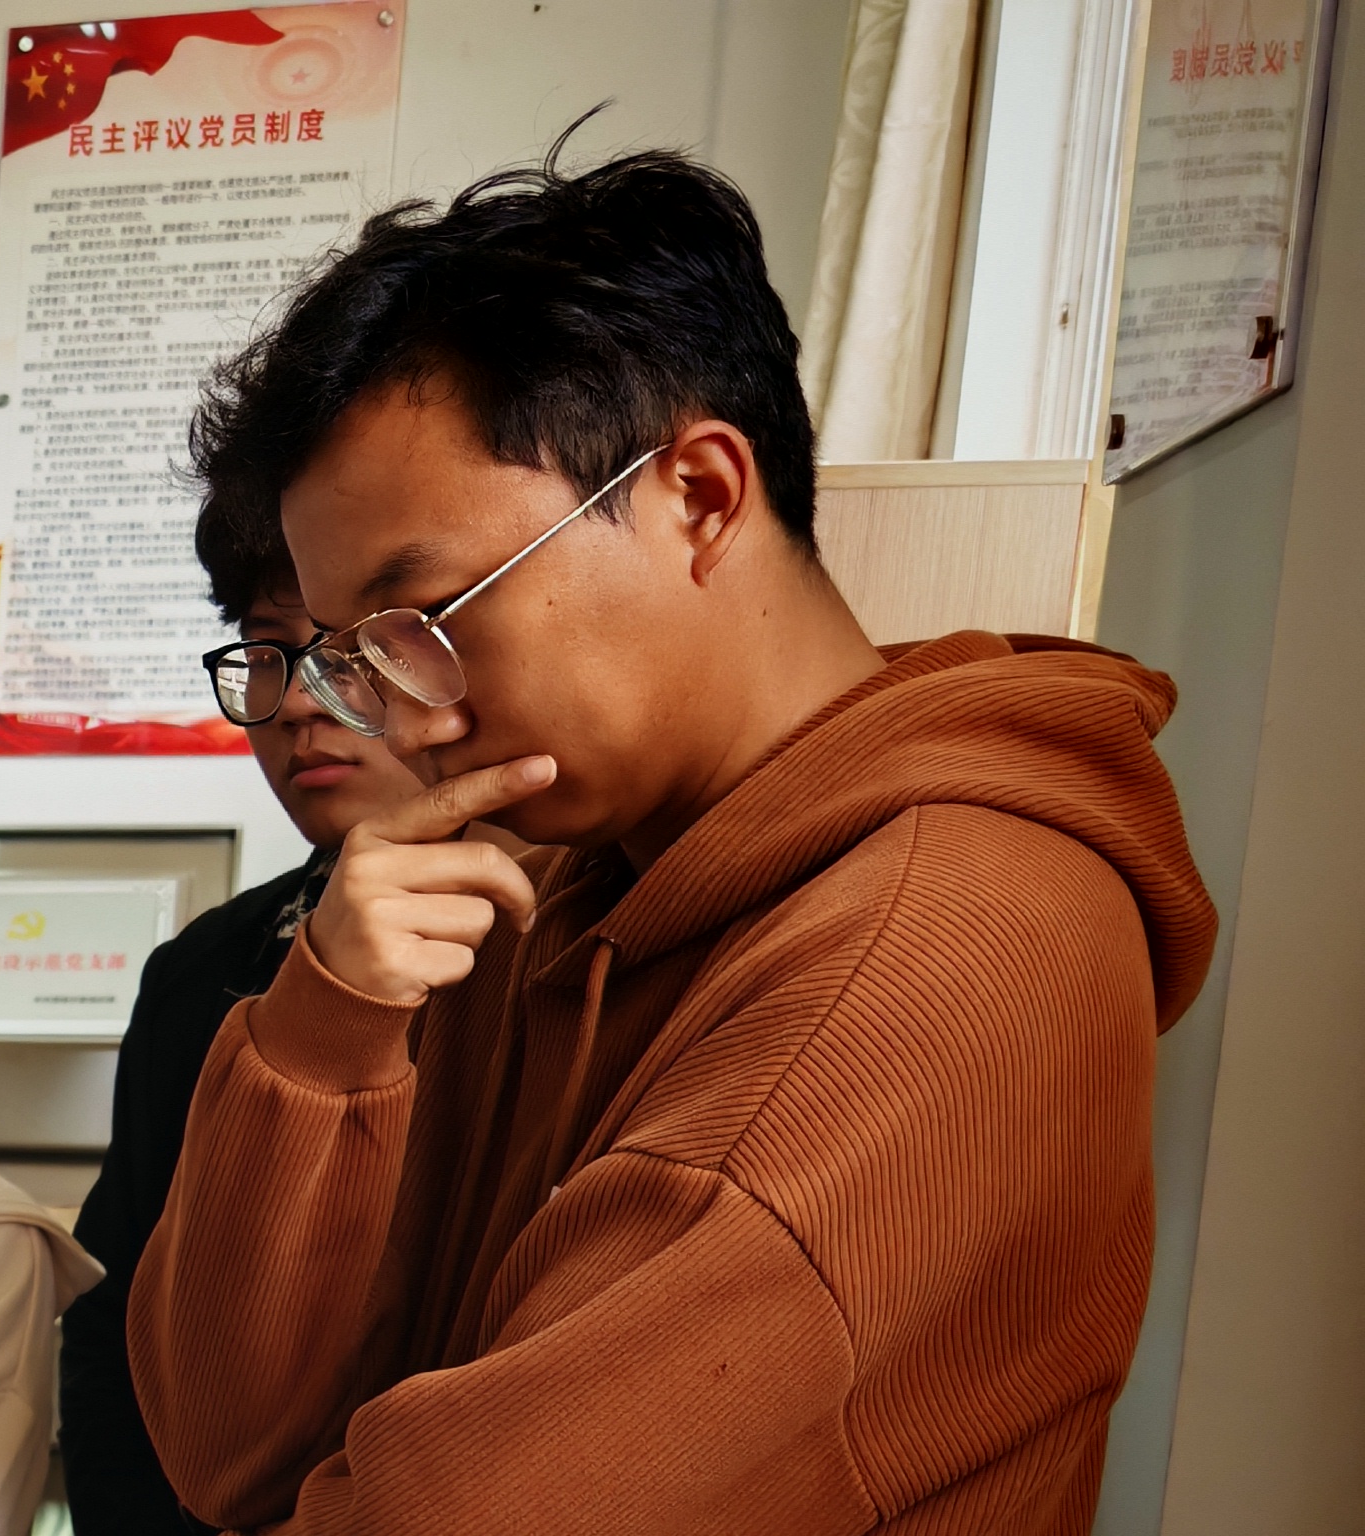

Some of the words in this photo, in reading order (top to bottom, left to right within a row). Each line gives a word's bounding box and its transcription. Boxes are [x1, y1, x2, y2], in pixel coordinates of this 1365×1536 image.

[69, 109, 326, 158] 民主评议党员制度
